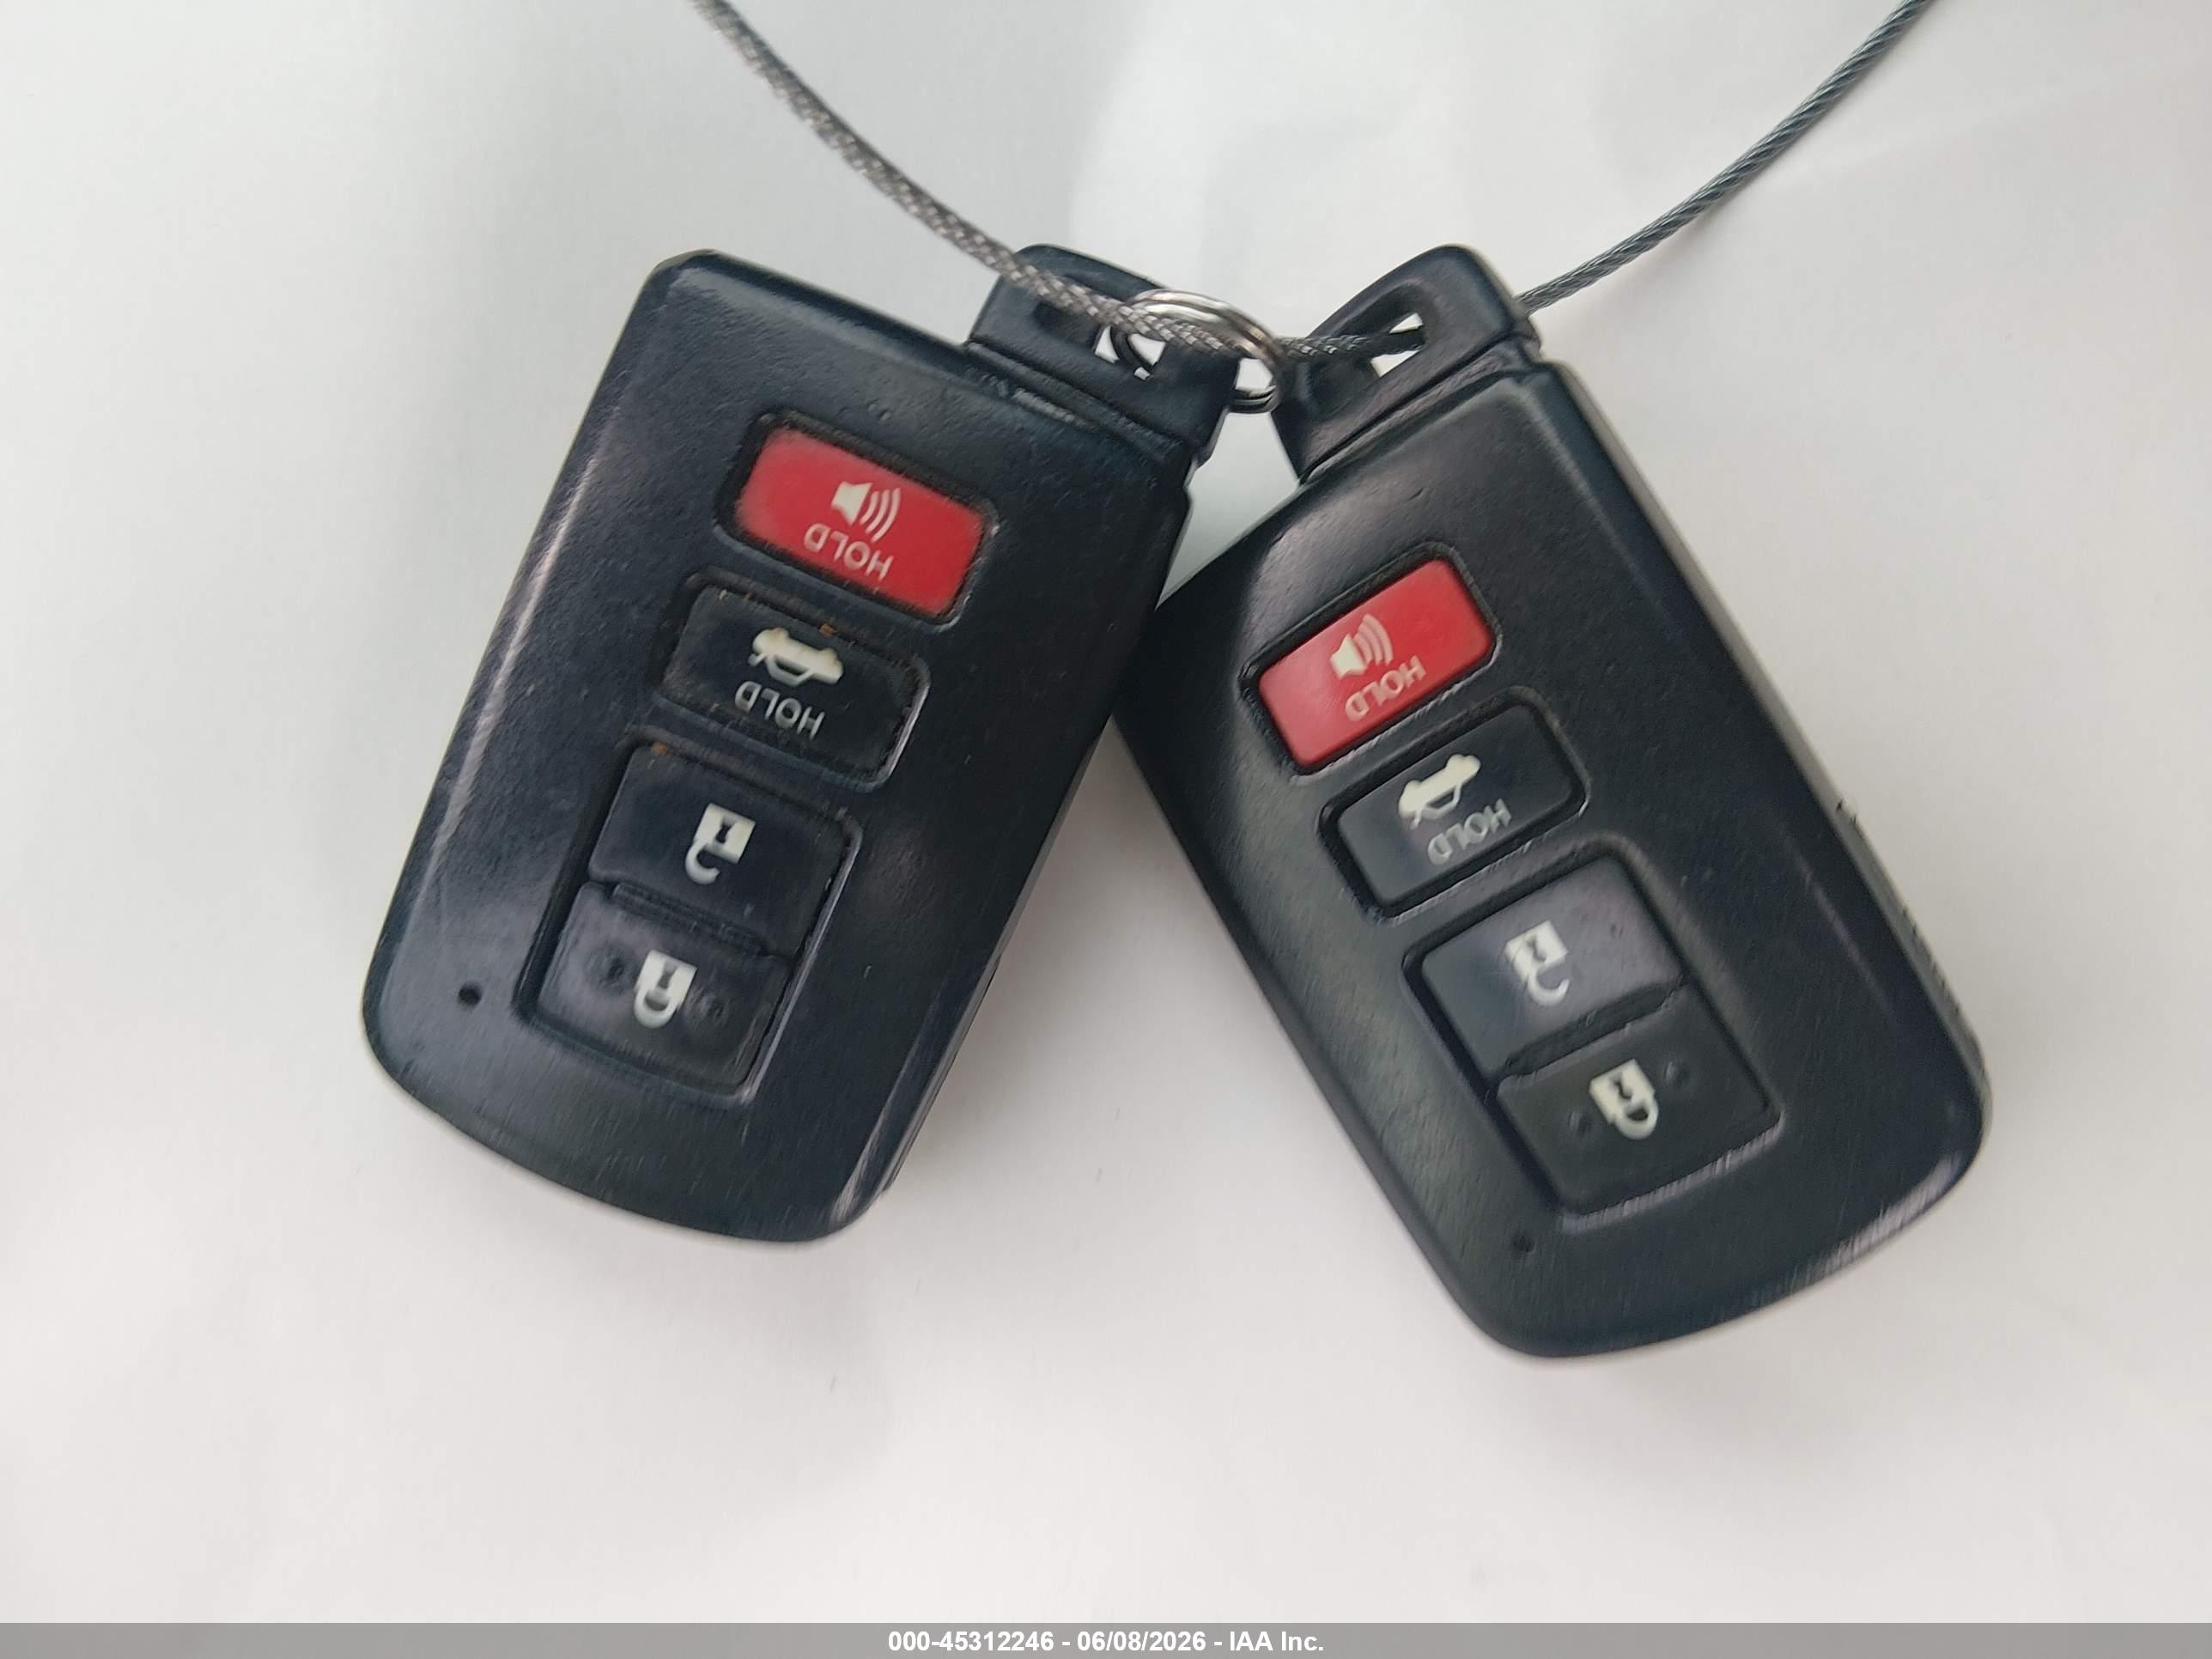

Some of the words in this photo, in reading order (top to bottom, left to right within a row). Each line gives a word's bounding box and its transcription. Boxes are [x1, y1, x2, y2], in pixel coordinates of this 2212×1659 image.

[804, 522, 895, 580] HOLD
[734, 680, 826, 739] HOLD
[1344, 654, 1427, 722] HOLD
[1427, 798, 1513, 866] HOLD
